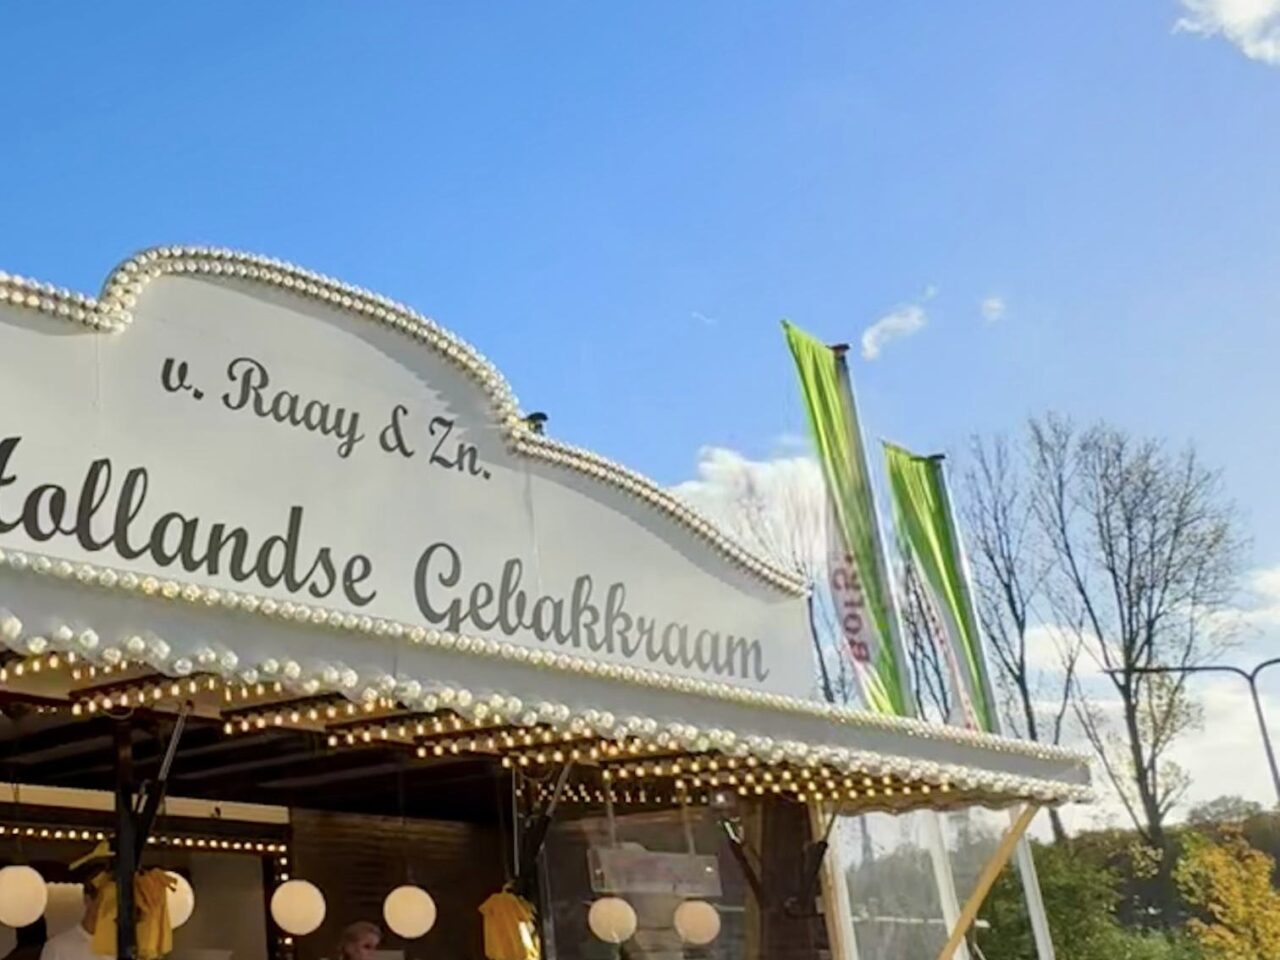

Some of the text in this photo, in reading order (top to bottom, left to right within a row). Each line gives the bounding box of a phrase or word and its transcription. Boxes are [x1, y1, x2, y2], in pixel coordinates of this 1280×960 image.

[161, 357, 491, 480] v. Raay & Zn.
[414, 542, 770, 683] Gebakkraam
